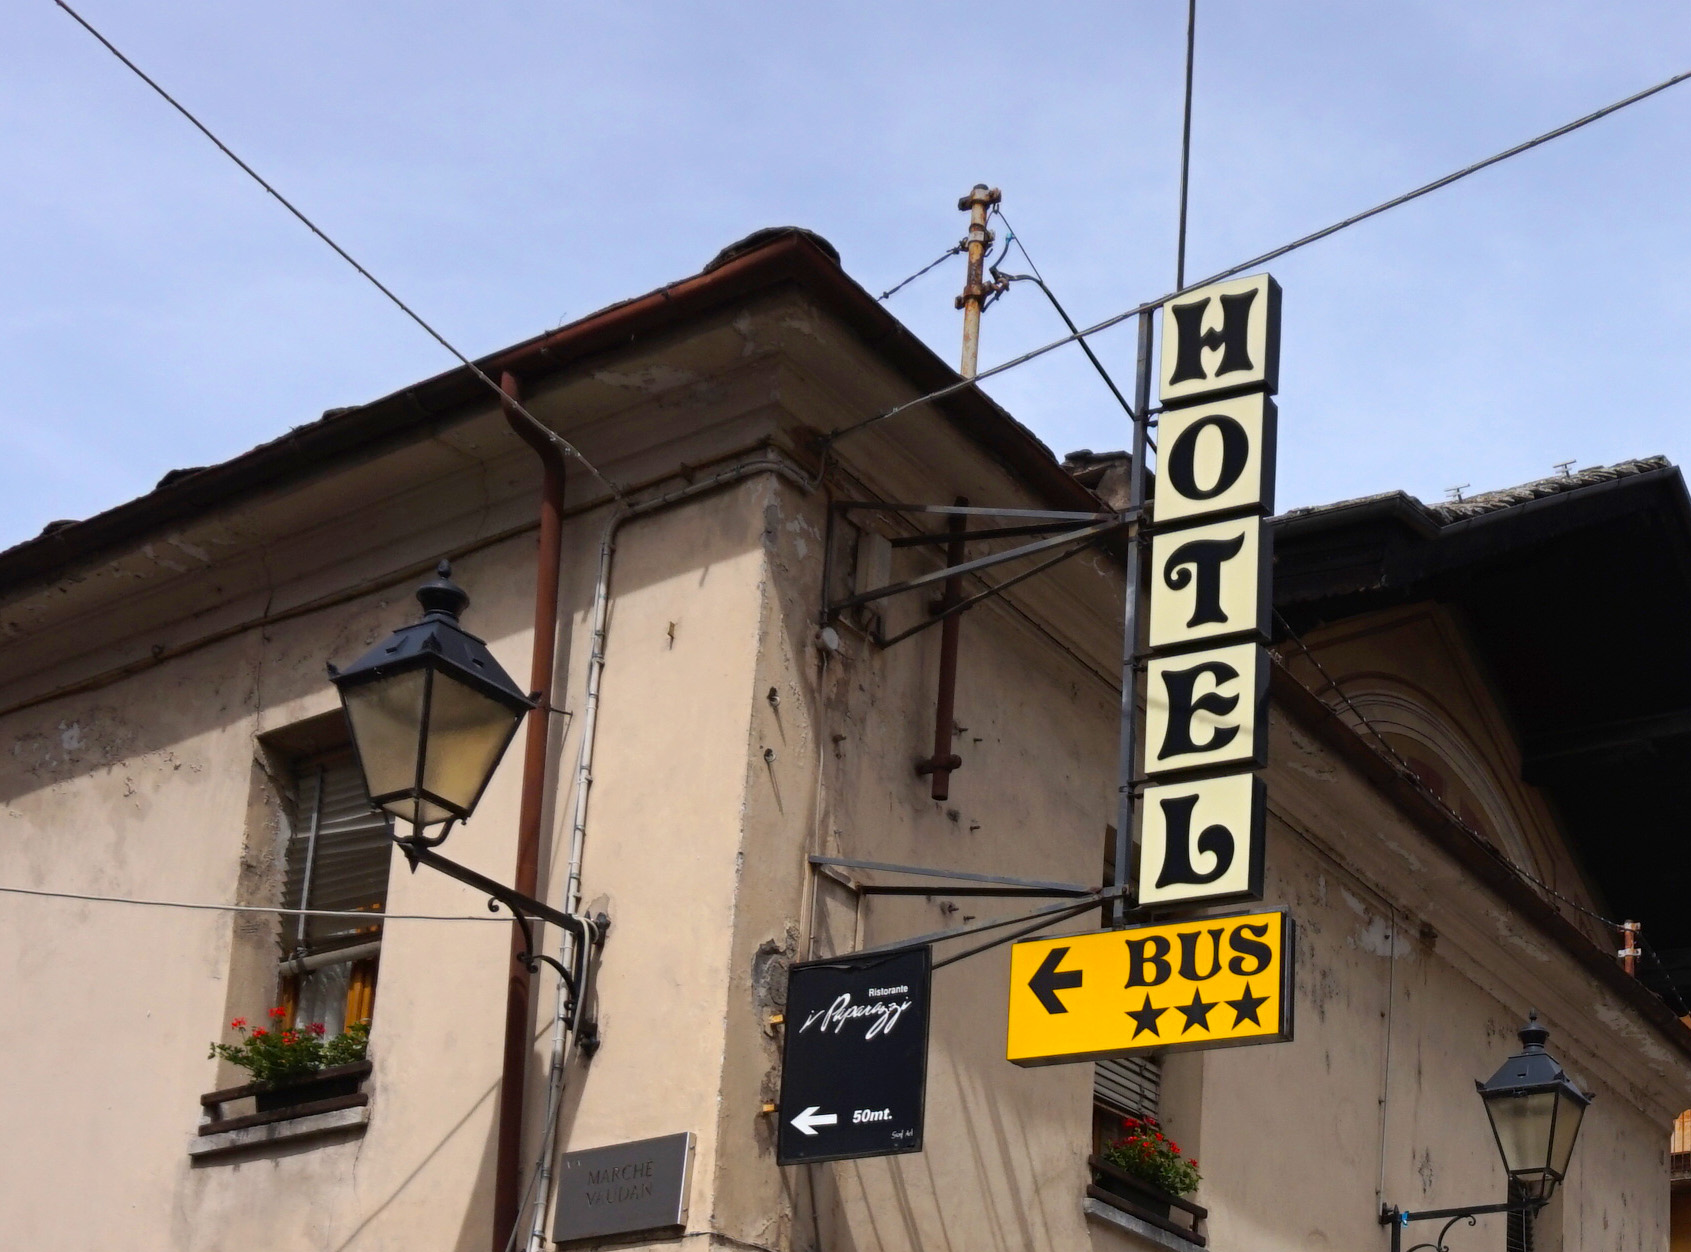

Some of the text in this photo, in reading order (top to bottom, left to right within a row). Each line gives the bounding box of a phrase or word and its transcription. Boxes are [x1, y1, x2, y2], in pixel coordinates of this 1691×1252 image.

[1156, 287, 1260, 888] HOTEL
[1125, 923, 1272, 989] BUS
[868, 984, 909, 997] Ristorante
[820, 992, 913, 1040] Paparazzi
[852, 1107, 893, 1123] 50mt.
[585, 1182, 653, 1207] VAUDAN
